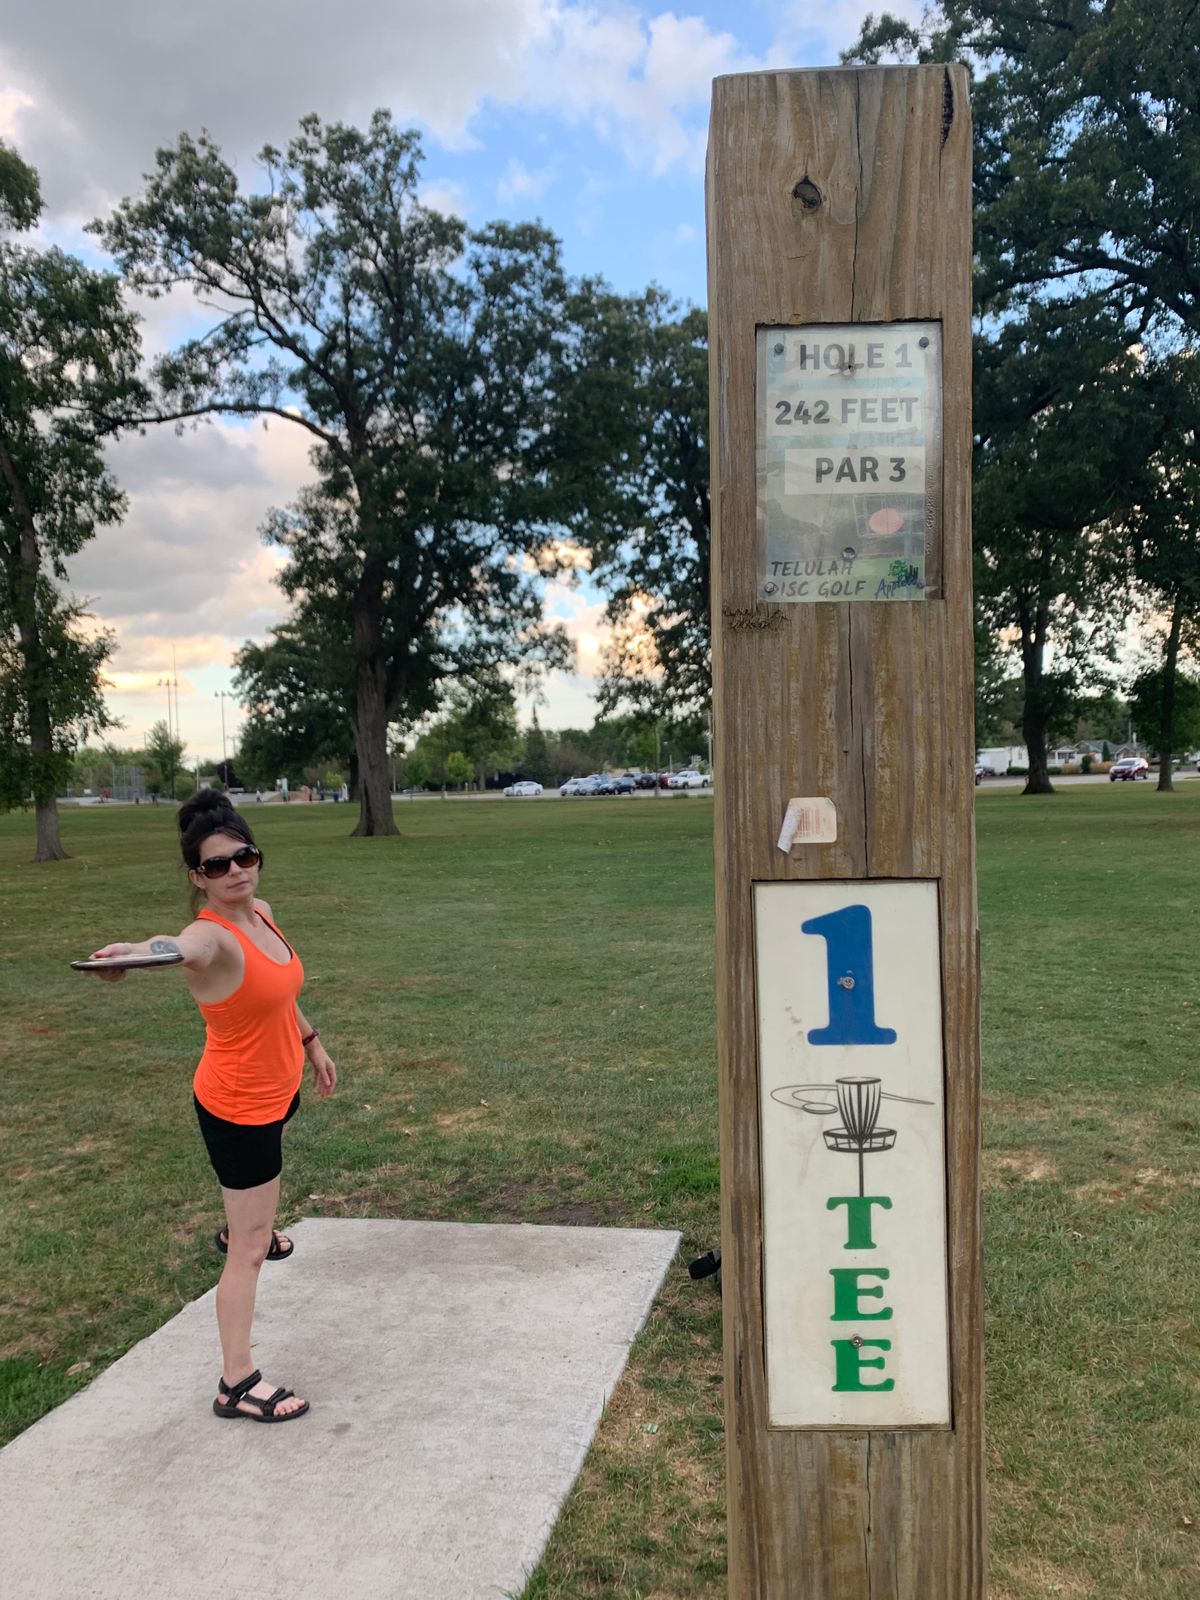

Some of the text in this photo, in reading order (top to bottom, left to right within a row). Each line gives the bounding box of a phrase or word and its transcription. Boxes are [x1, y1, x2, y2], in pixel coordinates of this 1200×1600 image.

[800, 343, 913, 370] HOLE 1
[775, 397, 919, 425] 242 FEET
[815, 457, 906, 483] PAR 3
[771, 560, 854, 577] TELULAH
[817, 580, 867, 598] GOLF
[801, 904, 897, 1046] 1
[826, 1196, 895, 1392] TEE
